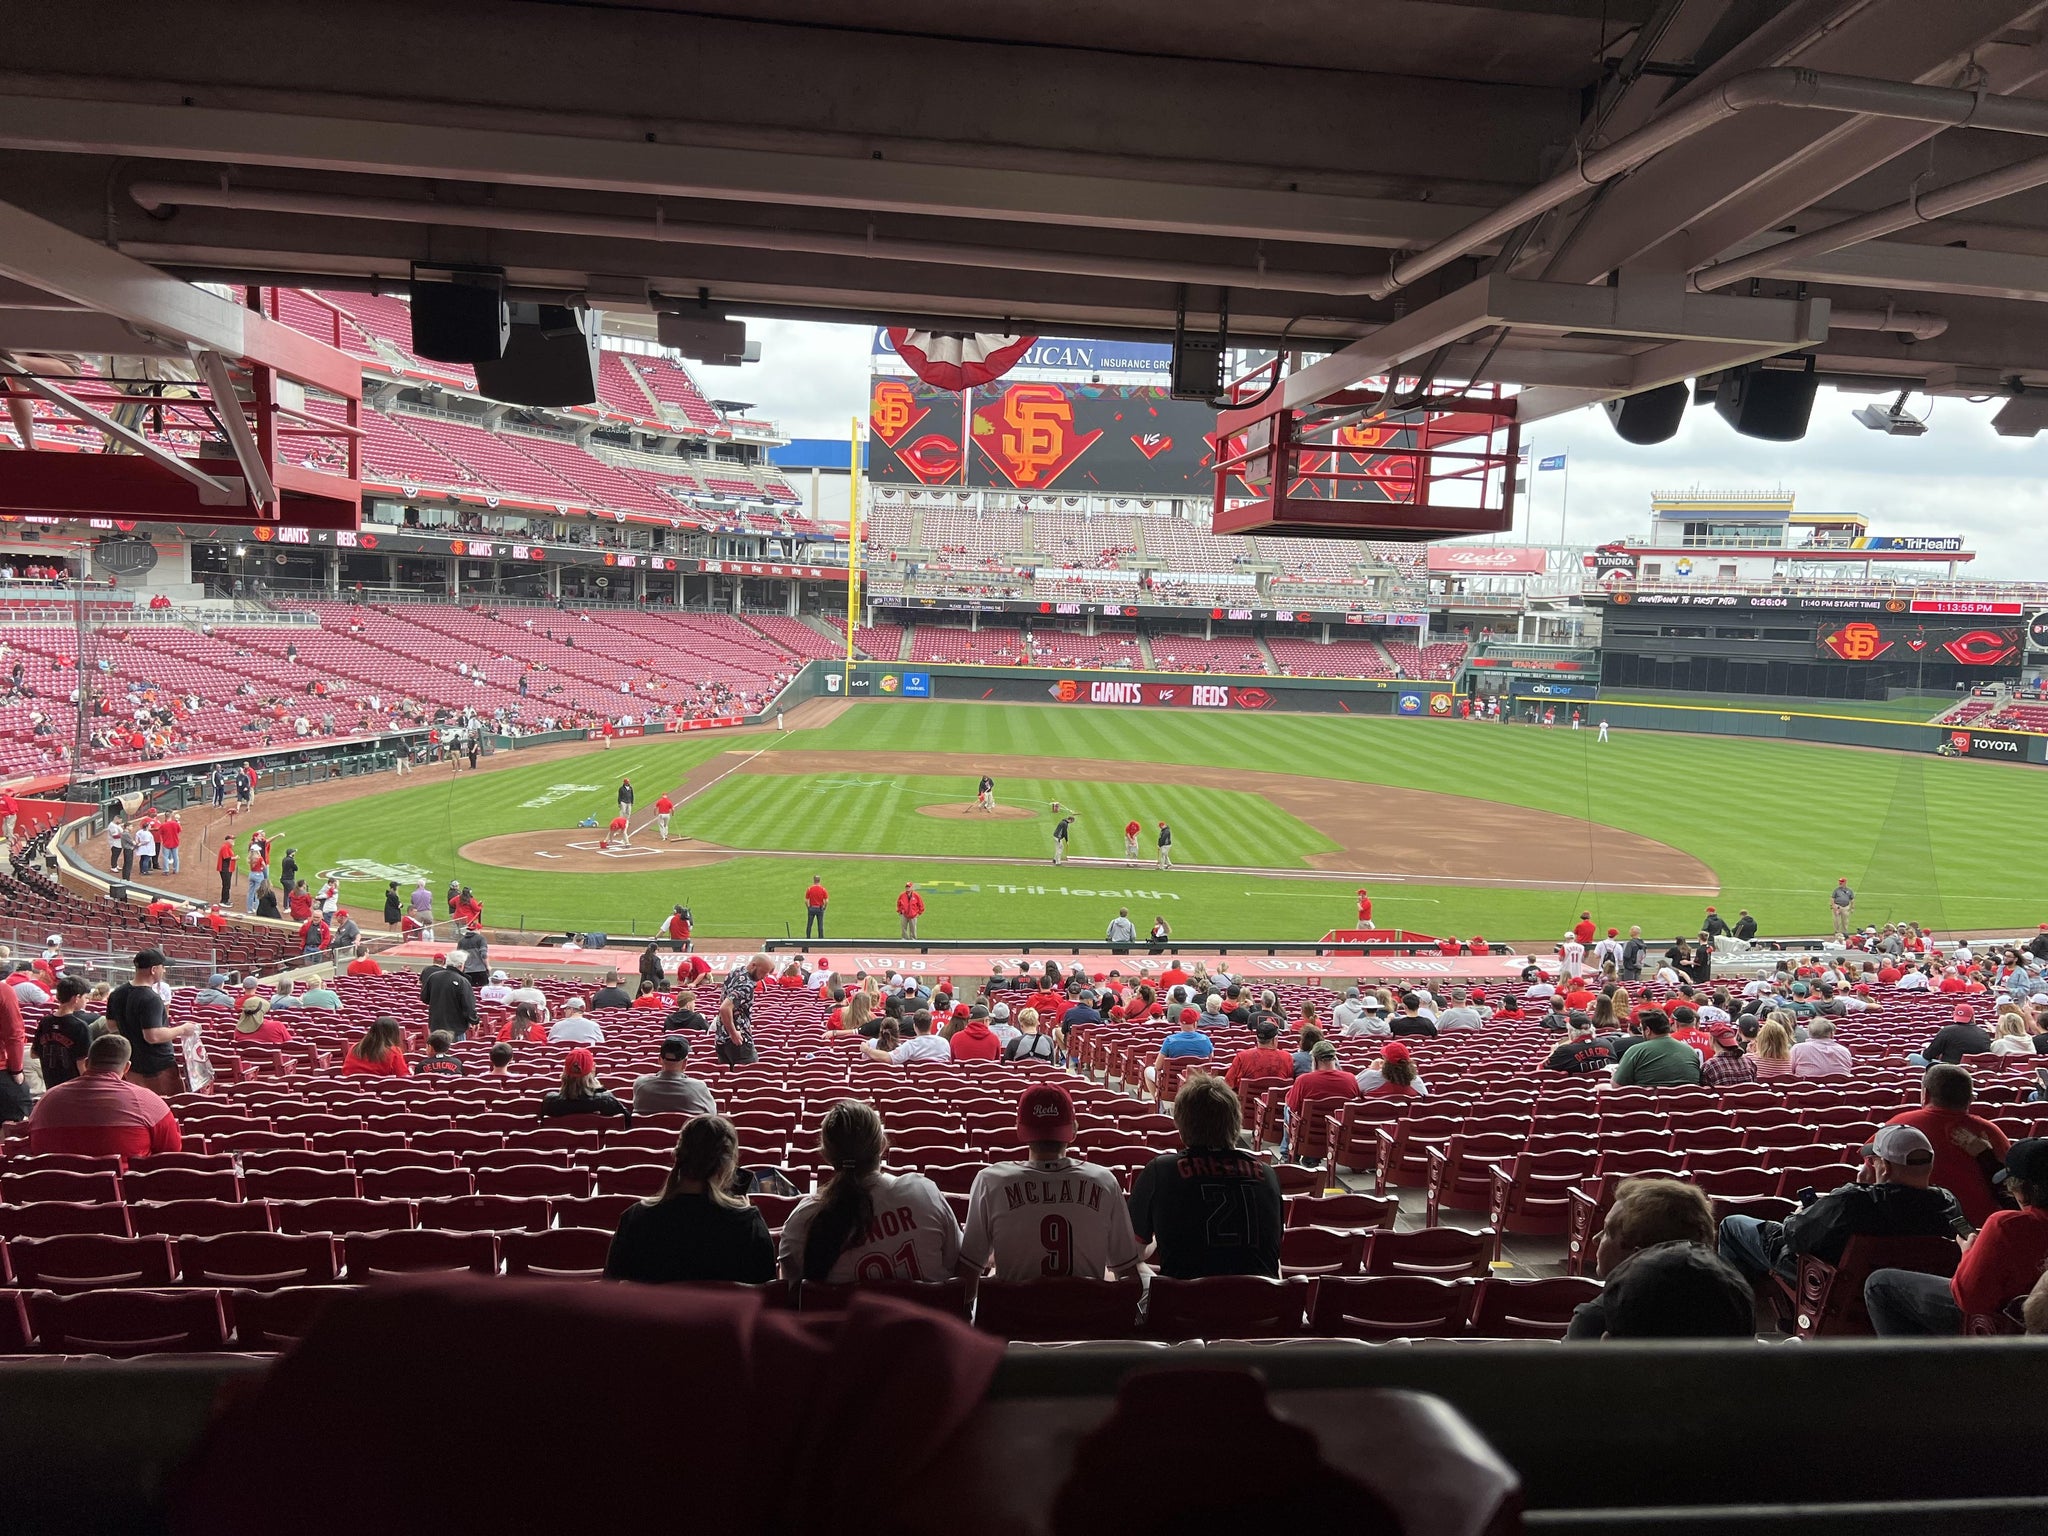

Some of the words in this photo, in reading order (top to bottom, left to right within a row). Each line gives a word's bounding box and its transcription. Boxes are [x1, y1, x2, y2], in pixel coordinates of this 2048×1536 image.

[1101, 358, 1150, 368] INSURANCE
[1153, 360, 1170, 369] GRO
[1143, 433, 1160, 445] VS
[279, 527, 309, 543] GIANTS
[337, 531, 357, 546] REDS
[1905, 538, 1960, 549] TriHealth
[469, 542, 492, 556] GIANTS
[513, 546, 528, 558] REDS
[651, 557, 664, 569] REDS
[1448, 552, 1517, 566] Reds
[1597, 557, 1634, 566] TUNDRA
[1638, 595, 1678, 604] COUNTDOWN
[1681, 596, 1689, 604] TO
[1693, 597, 1717, 605] FIRST
[1717, 597, 1737, 605] PITCH
[1750, 598, 1787, 606] 0:26:04
[1834, 600, 1858, 608] START
[1860, 601, 1880, 609] TIME]
[1056, 603, 1080, 614] GIANTS
[1103, 605, 1120, 615] REDS
[1937, 603, 1974, 612] 1:13:55
[1976, 604, 1993, 612] PM
[1228, 609, 1252, 620] GIANTS
[1276, 611, 1293, 621] REDS
[1091, 682, 1141, 703] GIANTS
[1159, 690, 1174, 700] VS
[1192, 685, 1228, 707] REDS
[1532, 684, 1572, 695] altafiber
[1973, 739, 2018, 752] TOYOTA
[987, 884, 1180, 900] TriHealth
[863, 957, 927, 971] 1919
[1256, 959, 1326, 973] 1976
[1382, 960, 1449, 972] 1990
[1574, 1051, 1585, 1062] DE
[1585, 1047, 1595, 1057] LA
[1594, 1046, 1610, 1057] CRUZ
[423, 1065, 432, 1073] DE
[442, 1063, 458, 1072] CRUZ
[1033, 1103, 1060, 1117] Reds
[1004, 1179, 1103, 1212] MCLAIN
[1040, 1213, 1074, 1277] 9
